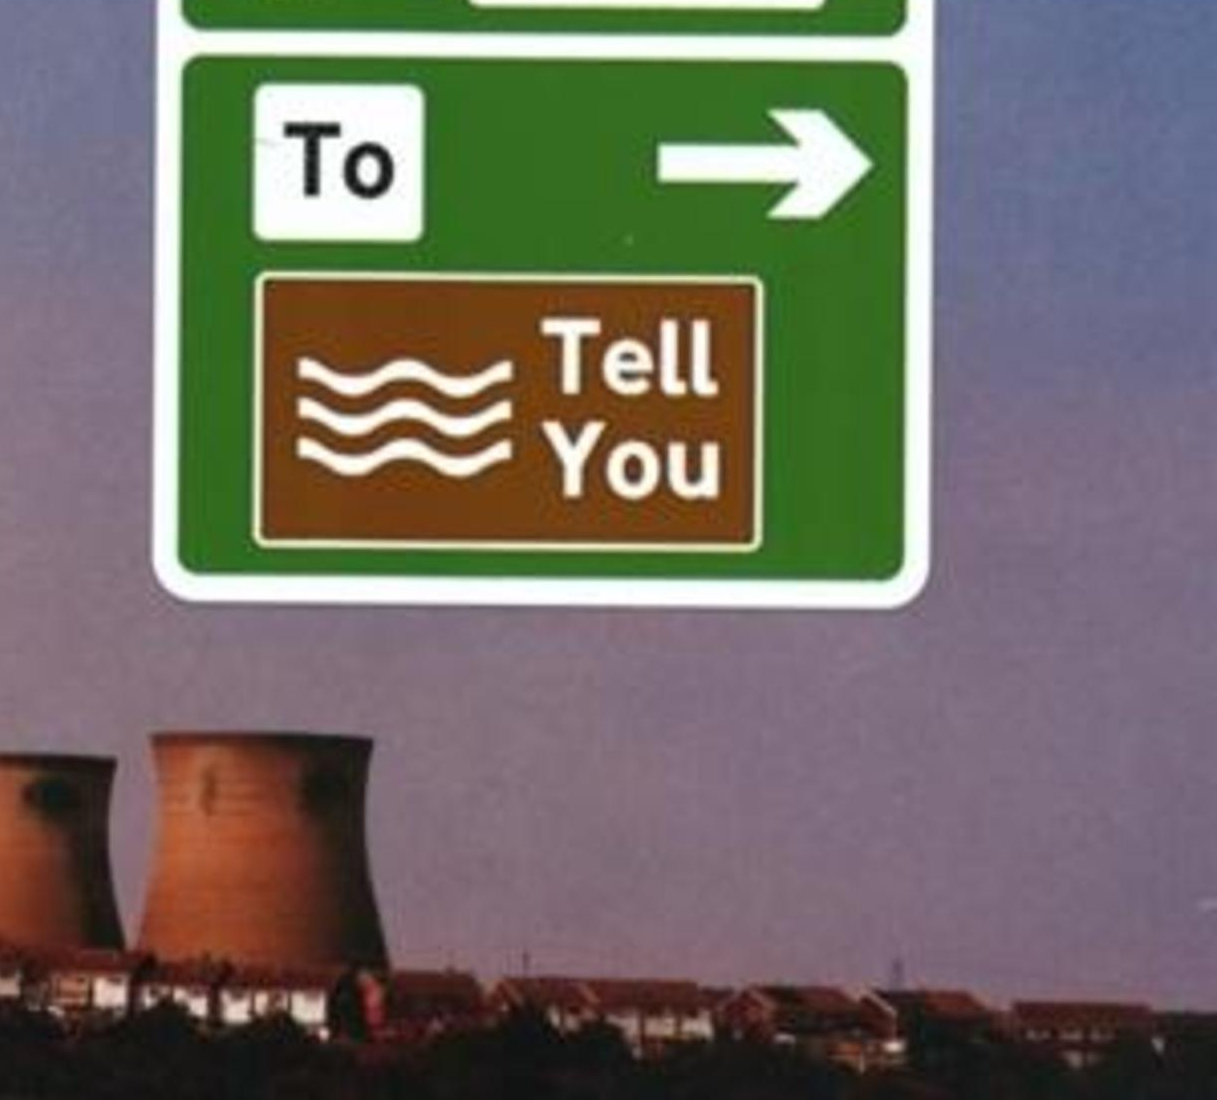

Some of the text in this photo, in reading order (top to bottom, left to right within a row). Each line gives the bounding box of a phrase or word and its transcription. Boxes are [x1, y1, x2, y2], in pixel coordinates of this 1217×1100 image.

[284, 123, 396, 200] To
[540, 317, 718, 396] Tell
[540, 421, 721, 498] You
